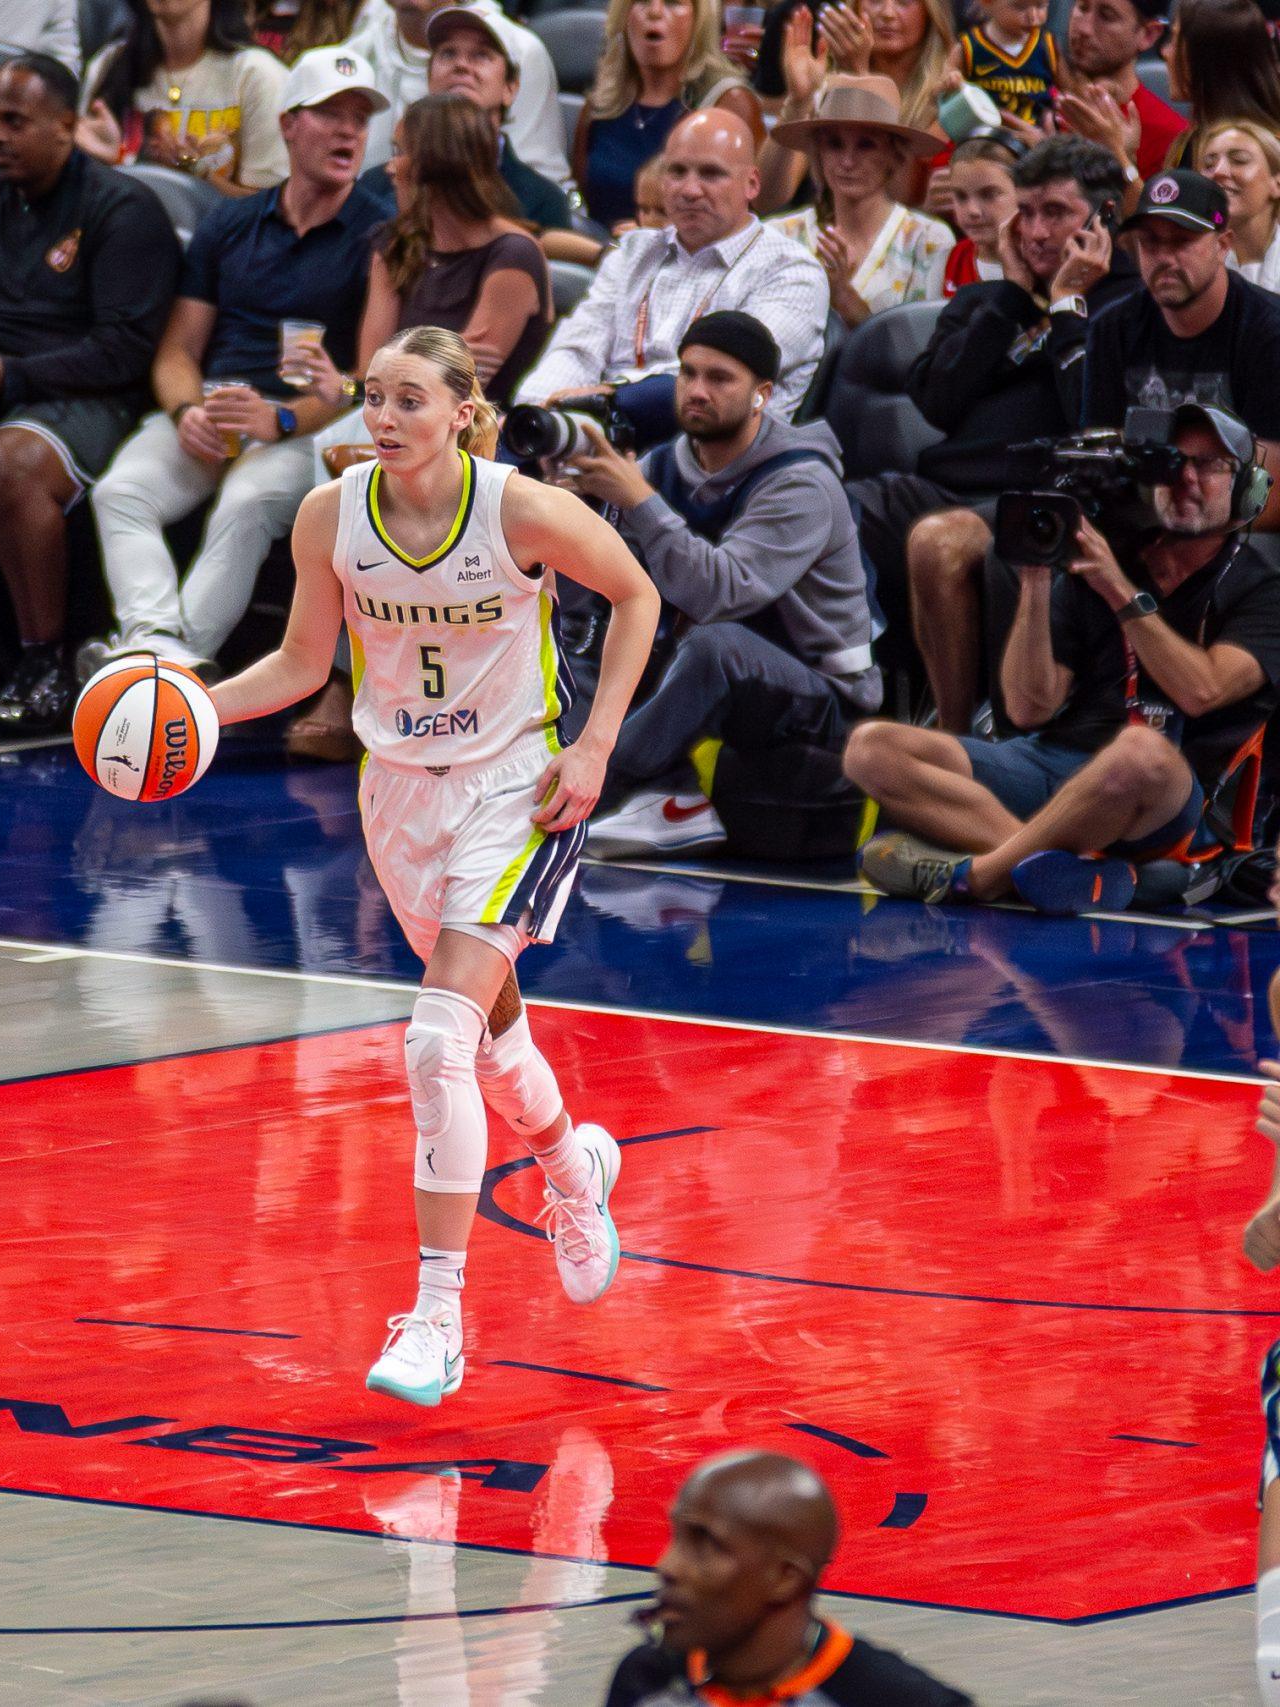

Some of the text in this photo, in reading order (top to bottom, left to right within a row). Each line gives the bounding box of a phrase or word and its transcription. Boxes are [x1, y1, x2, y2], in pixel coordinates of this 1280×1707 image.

[456, 568, 492, 583] Albert
[354, 590, 504, 625] WINGS
[418, 643, 448, 701] 5
[152, 715, 188, 800] Wilson
